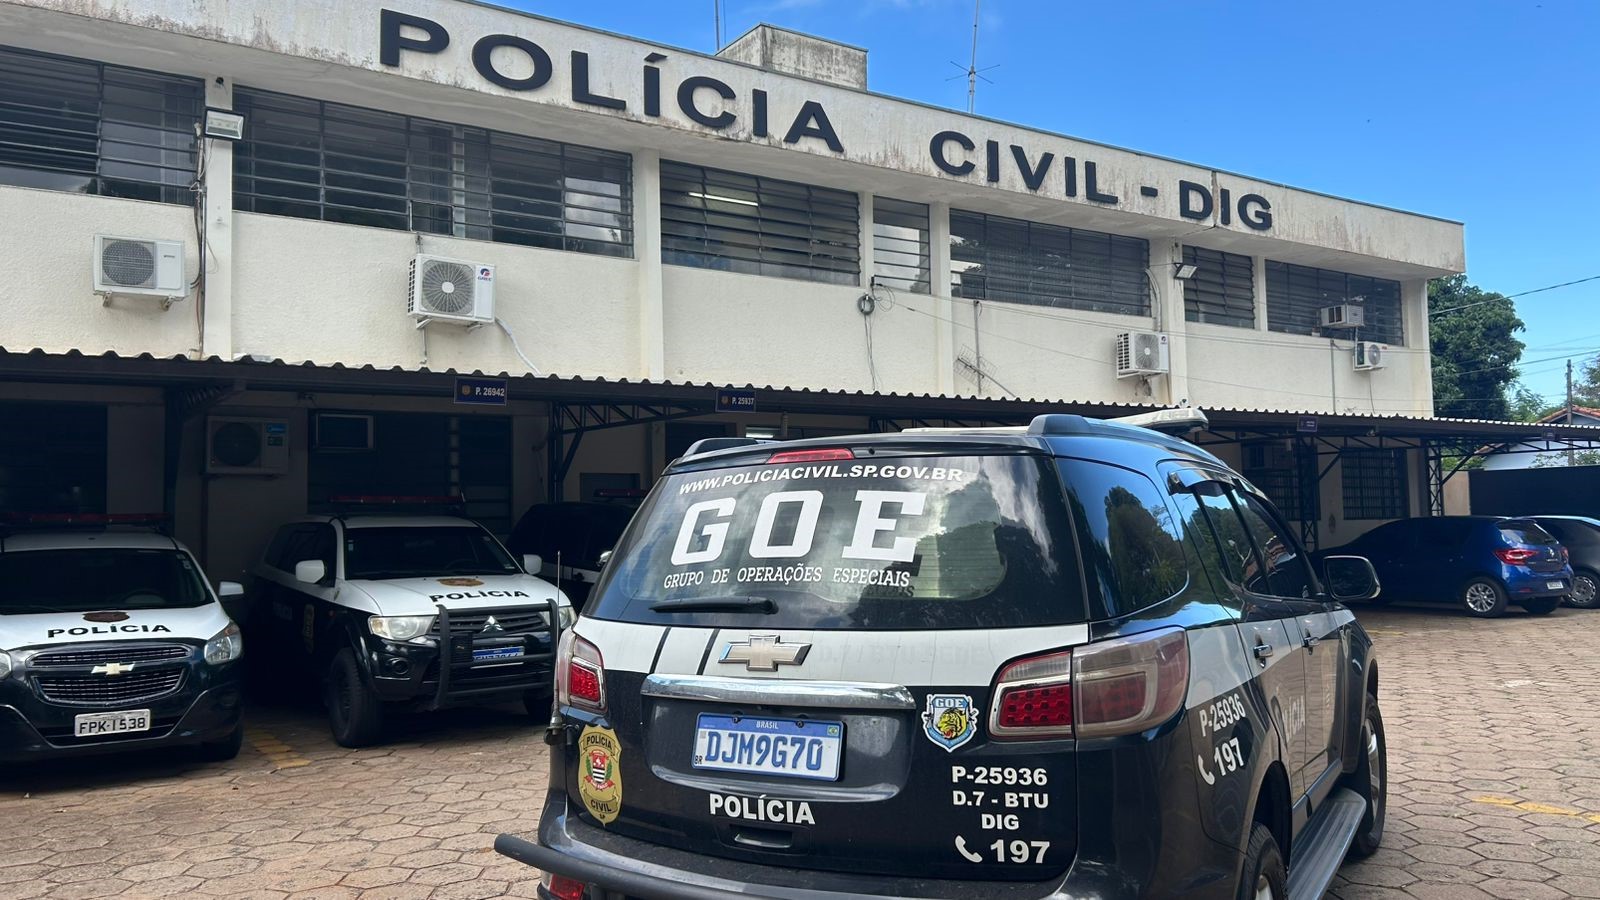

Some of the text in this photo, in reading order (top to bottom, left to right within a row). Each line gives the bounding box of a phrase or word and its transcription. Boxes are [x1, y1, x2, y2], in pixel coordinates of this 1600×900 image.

[380, 8, 1273, 231] POLÍCIA CIVIL - DIG
[680, 466, 963, 494] WWW.POLICIACIVIL.SP.GOV.BR
[671, 490, 927, 565] GOE
[663, 563, 911, 589] GRUPO DE OPERAÇÕES ESPECIAIS
[47, 624, 171, 638] POLÍCIA
[935, 698, 964, 708] GOE
[1199, 693, 1246, 737] P-25936
[79, 717, 146, 734] FPK-1538
[756, 720, 778, 730] BRASIL
[704, 731, 824, 771] DJM9G70
[1213, 737, 1244, 776] 197
[951, 765, 1048, 786] P-25936
[590, 799, 612, 812] CIVIL
[709, 794, 816, 825] POLÍCIA
[952, 790, 985, 806] D.7
[1004, 792, 1049, 809] BTU
[981, 813, 1020, 830] DIG
[990, 839, 1051, 864] 197
